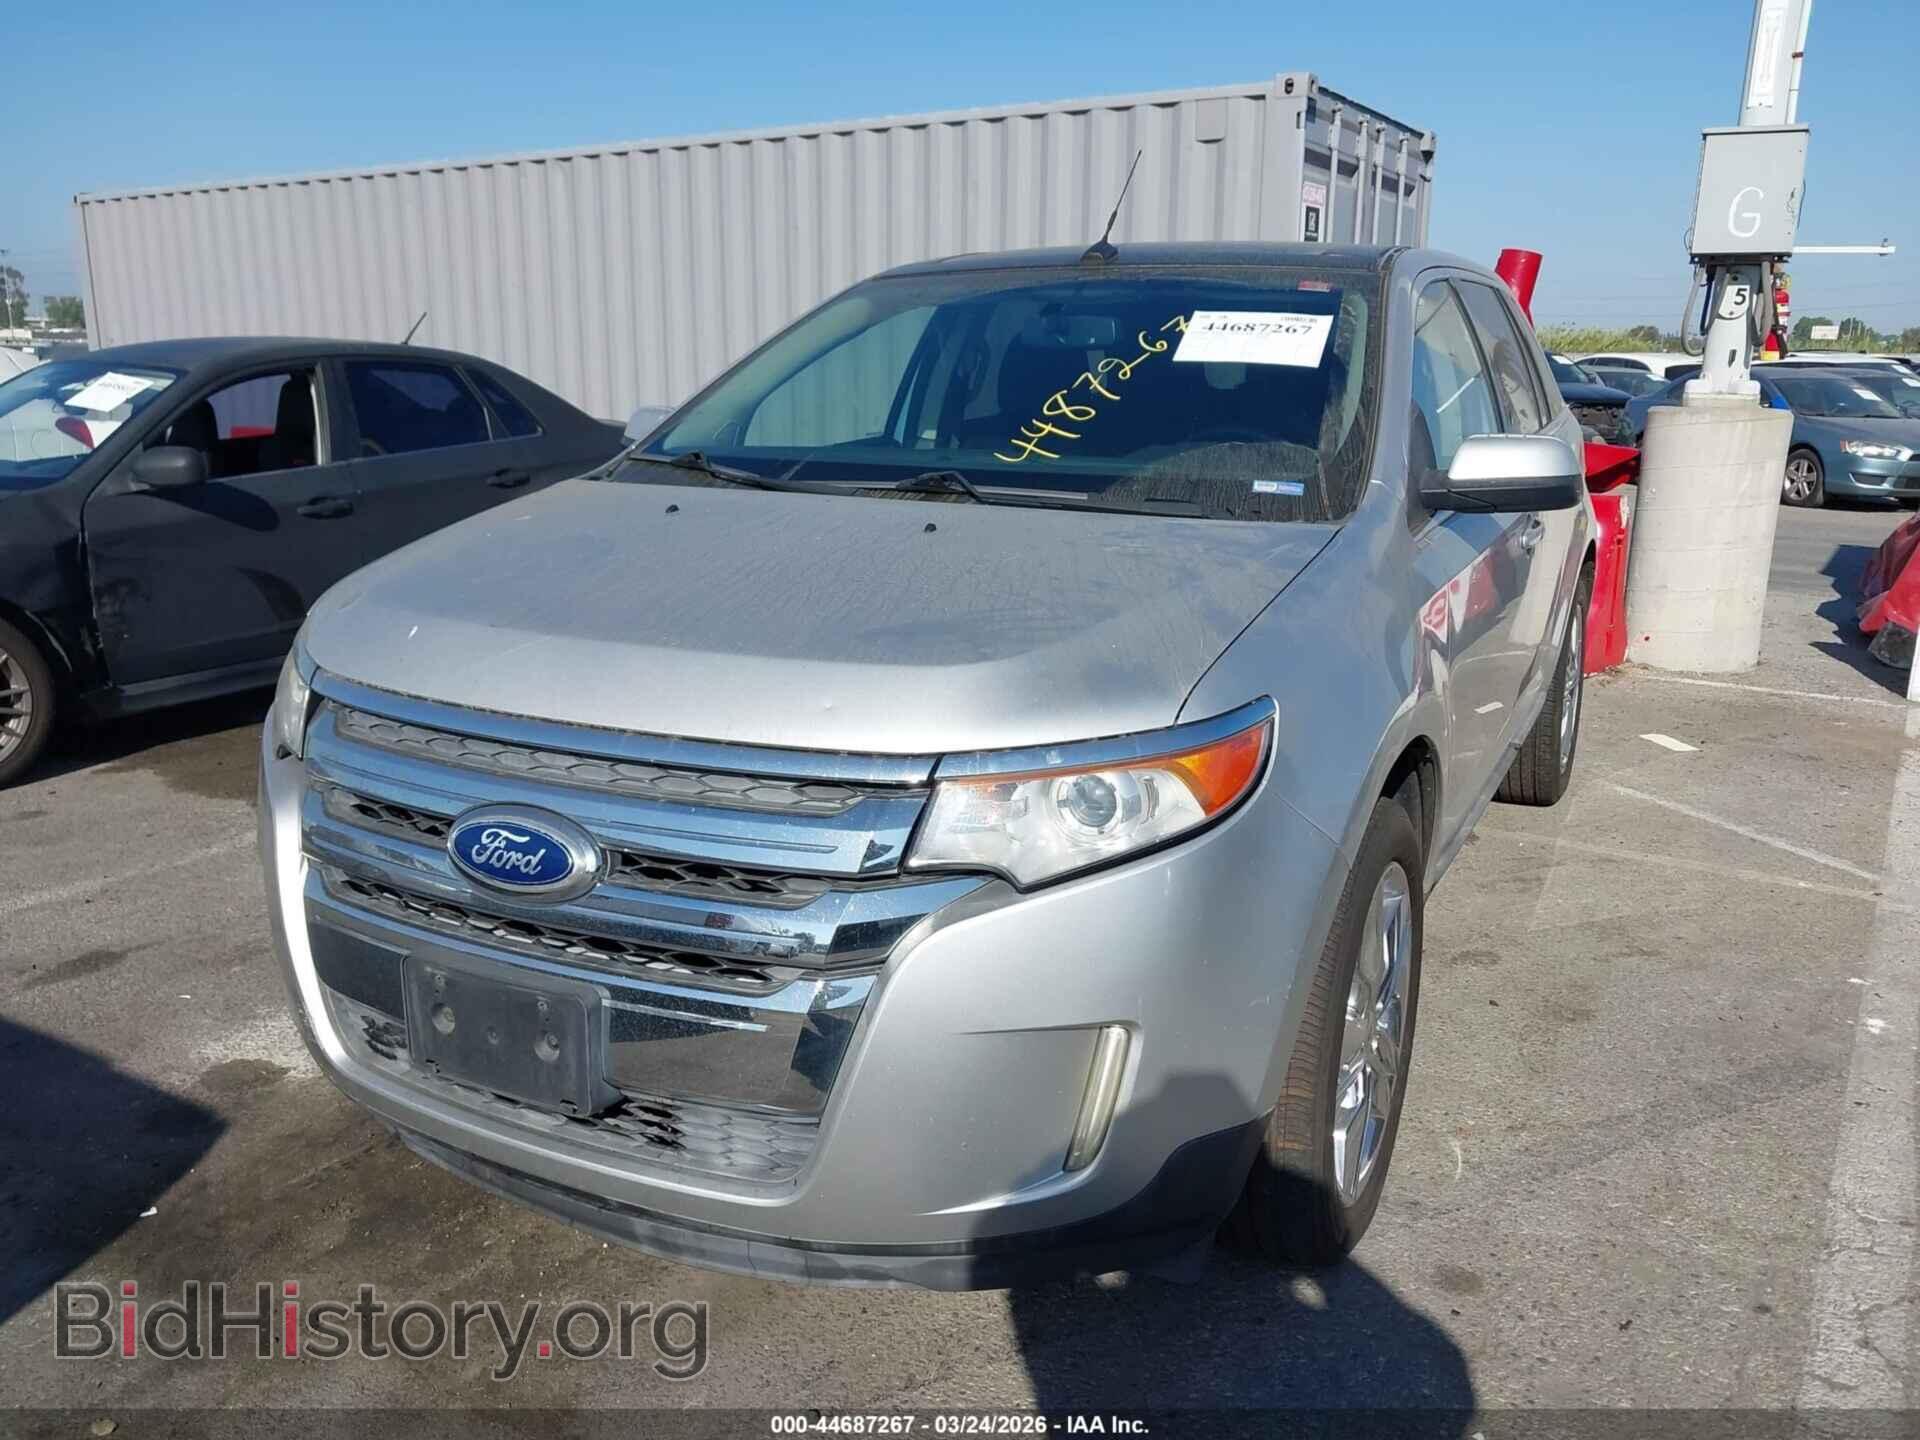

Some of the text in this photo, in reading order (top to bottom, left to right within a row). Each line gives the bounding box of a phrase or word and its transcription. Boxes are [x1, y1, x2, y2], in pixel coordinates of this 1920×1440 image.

[1728, 186, 1764, 237] G
[1734, 288, 1747, 305] 5
[1201, 321, 1313, 335] 44687267
[471, 827, 547, 876] Ford
